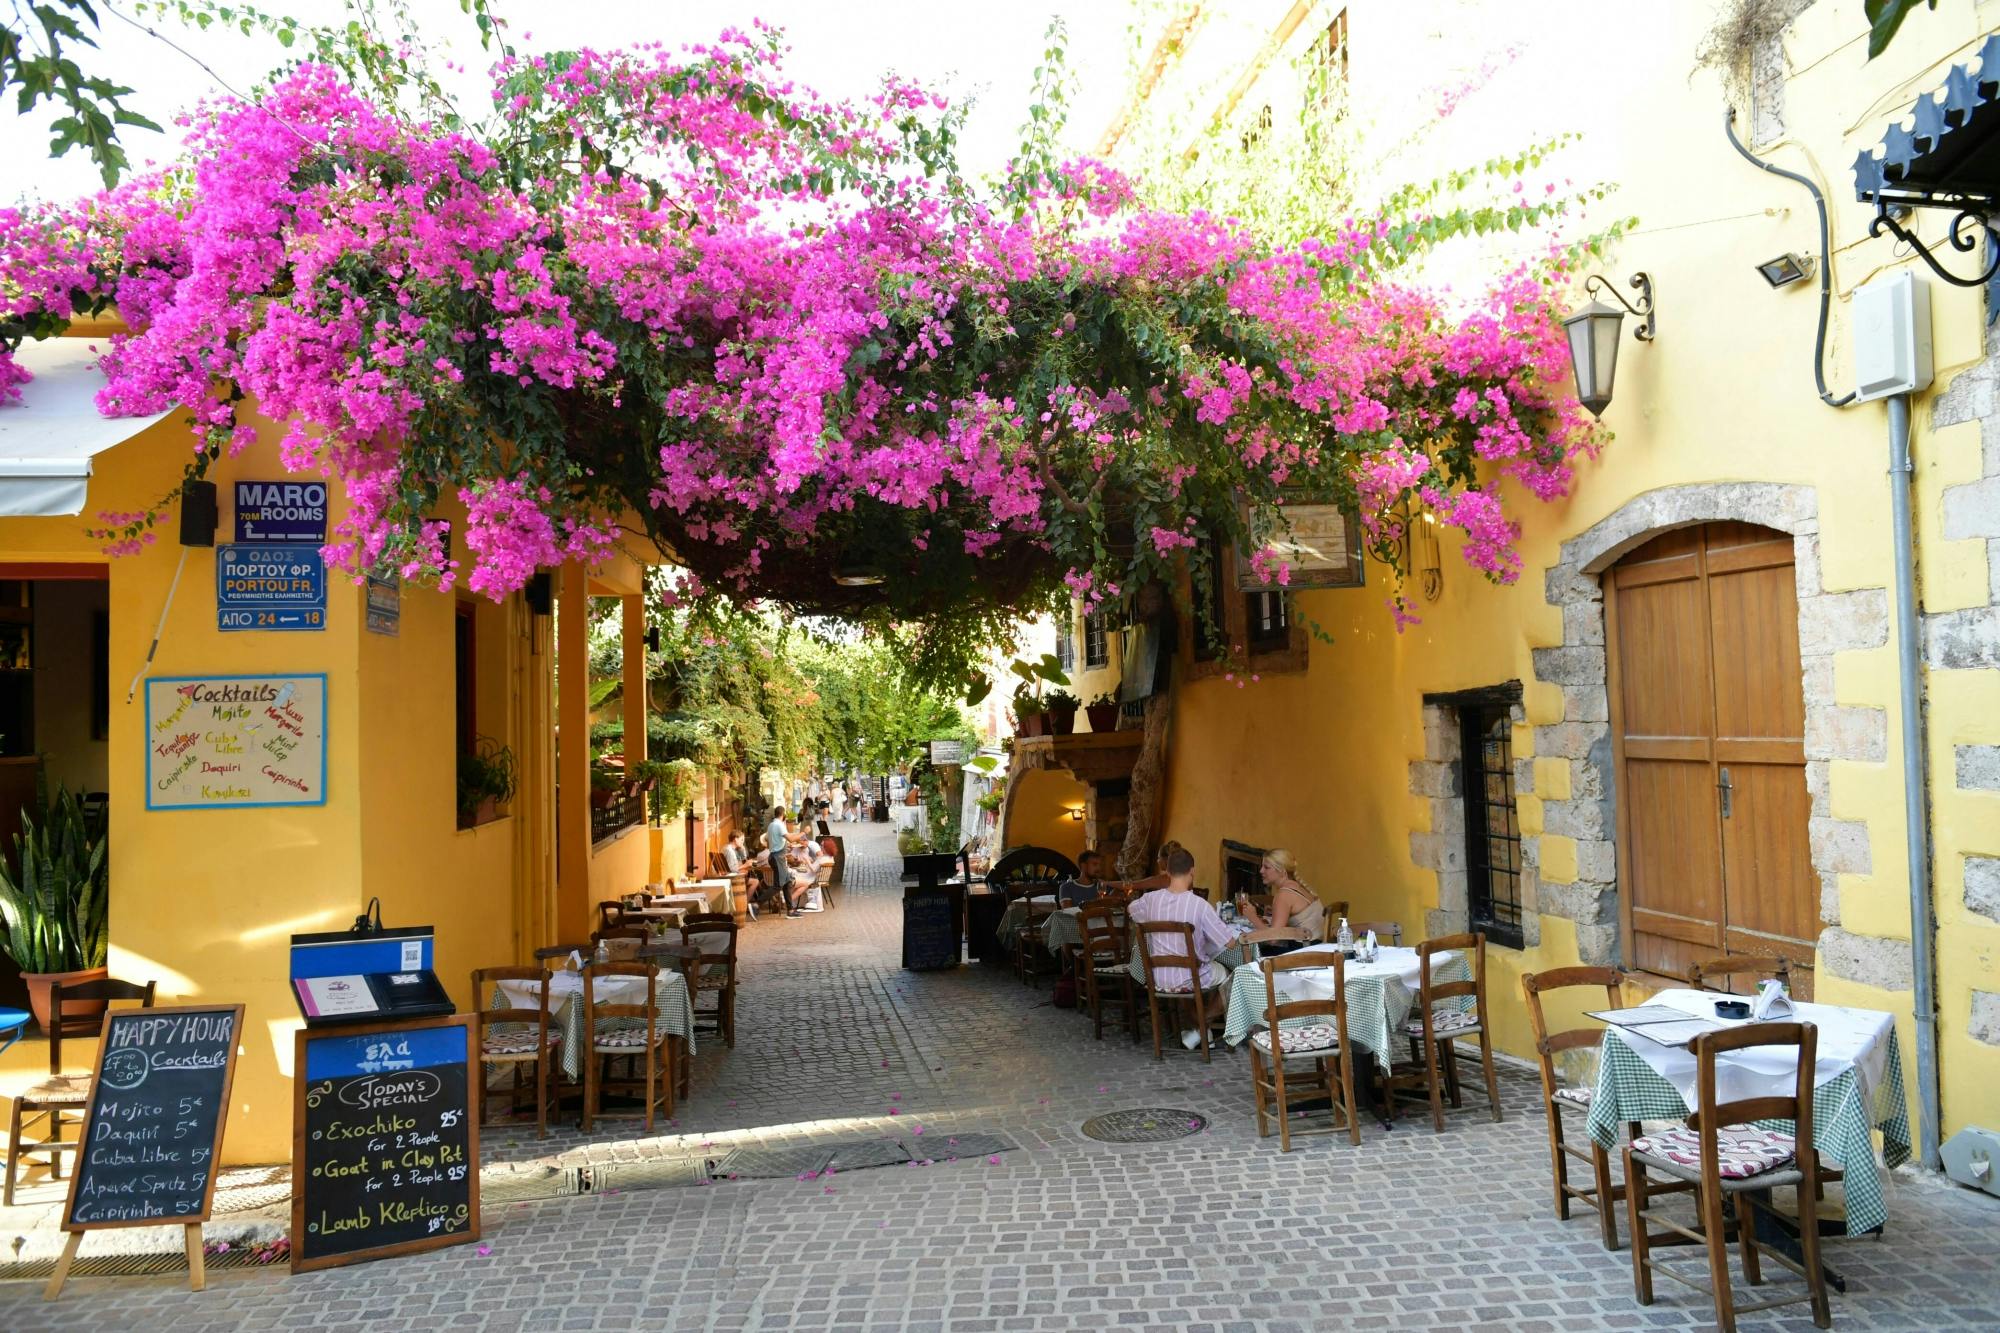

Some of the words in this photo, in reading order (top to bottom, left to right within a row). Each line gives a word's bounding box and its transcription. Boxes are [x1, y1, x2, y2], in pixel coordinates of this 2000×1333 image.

[239, 484, 325, 506] MARO
[240, 512, 260, 520] 70M
[261, 507, 323, 520] ROOMS
[249, 551, 294, 562] ΟΔΟΣ
[226, 564, 287, 576] ΠΟΡΤΟΥ
[290, 564, 315, 576] ΦΡ.
[226, 580, 288, 592] PORTOU
[292, 580, 315, 592] FR.
[222, 612, 252, 625] ΑΠΟ
[258, 613, 276, 625] 24
[304, 612, 320, 624] 18
[192, 683, 278, 702] Cocktails
[212, 703, 251, 722] Mojito
[215, 743, 245, 754] Libre
[111, 1017, 182, 1048] HAPPY
[181, 1016, 232, 1044] HOUR
[151, 1049, 227, 1070] Cocktails
[358, 1091, 428, 1110] SPECIAL
[100, 1102, 162, 1121] Mojito
[95, 1121, 160, 1145] Daquiri
[326, 1114, 416, 1140] Exochiko
[396, 1135, 406, 1149] 2
[408, 1130, 440, 1146] People
[91, 1147, 136, 1165] Cuba
[141, 1145, 181, 1163] Libre
[324, 1156, 369, 1178] Goat
[382, 1158, 395, 1170] in
[401, 1149, 435, 1169] Clay
[440, 1144, 463, 1164] Pot
[81, 1174, 137, 1198] Aperol
[140, 1174, 187, 1194] Spritz
[393, 1173, 403, 1187] 2
[409, 1169, 443, 1185] People
[75, 1200, 164, 1223] Caipirinha
[321, 1205, 371, 1235] Lamb
[379, 1196, 449, 1225] Kleftico
